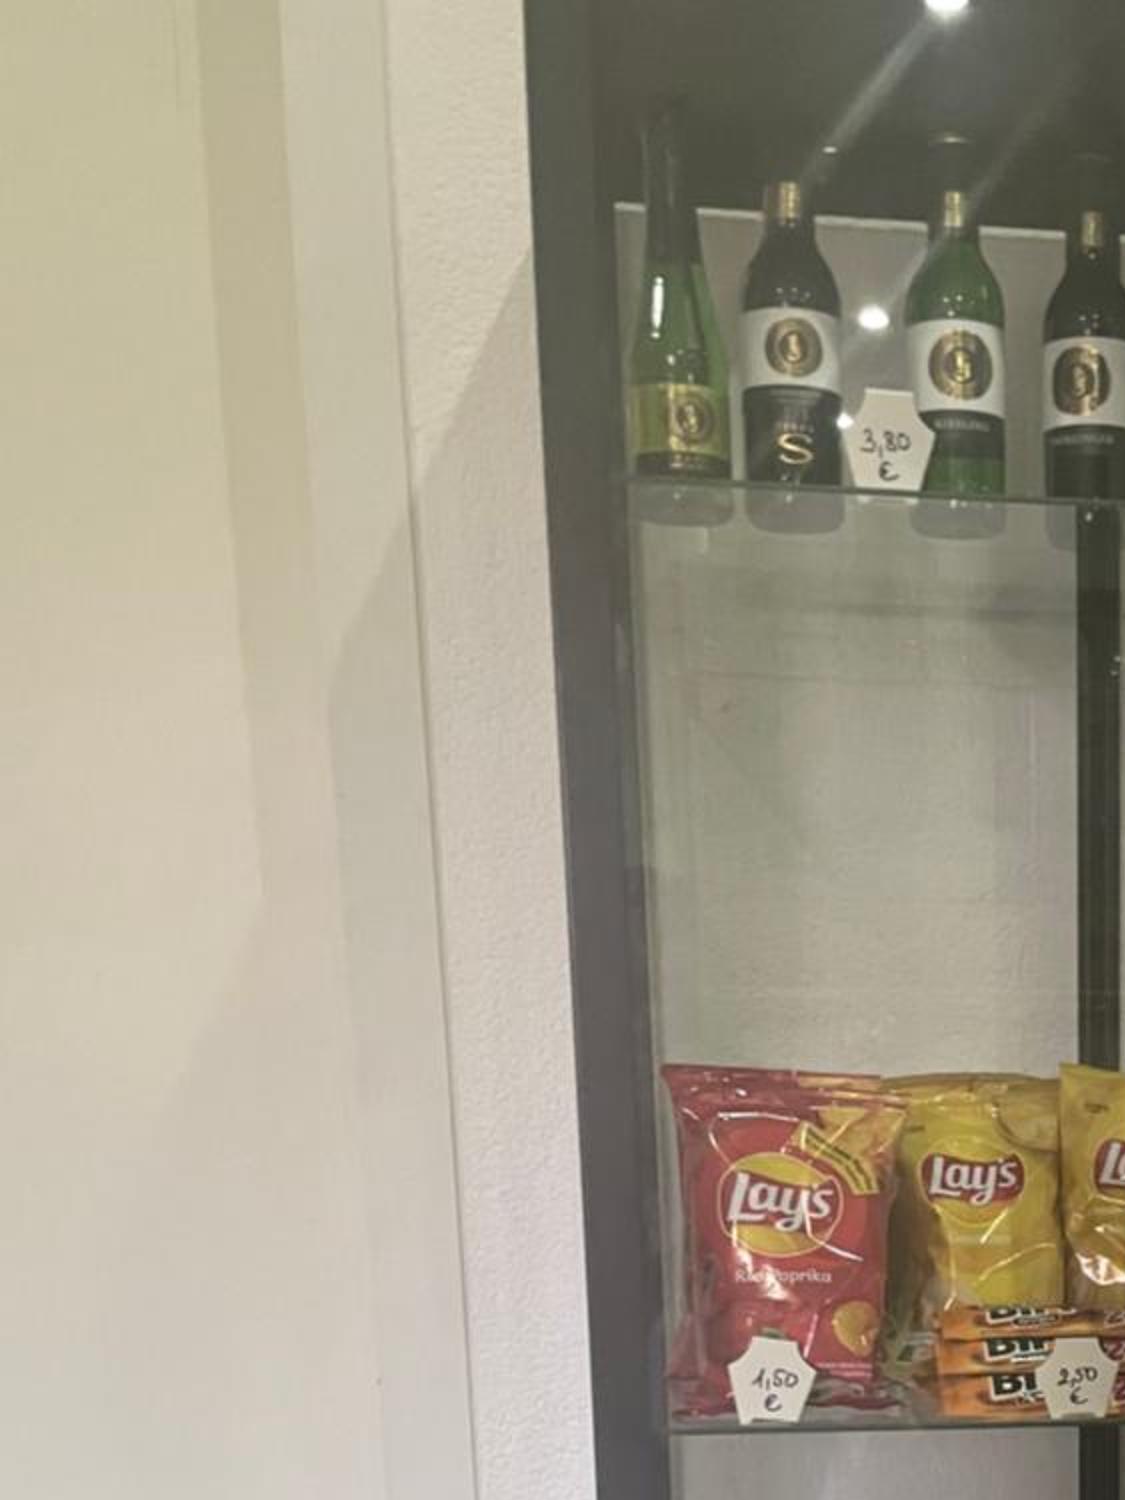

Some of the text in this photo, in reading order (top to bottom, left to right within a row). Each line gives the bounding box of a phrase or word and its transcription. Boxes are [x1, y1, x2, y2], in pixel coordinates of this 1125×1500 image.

[776, 432, 814, 464] S
[860, 427, 912, 459] 3,80
[879, 460, 900, 482] €
[928, 1155, 1018, 1206] Lay's
[726, 1172, 834, 1232] Lay's
[751, 1368, 800, 1389] 1,50
[1056, 1365, 1098, 1388] 2,50
[765, 1393, 783, 1412] €
[1069, 1387, 1089, 1405] €
